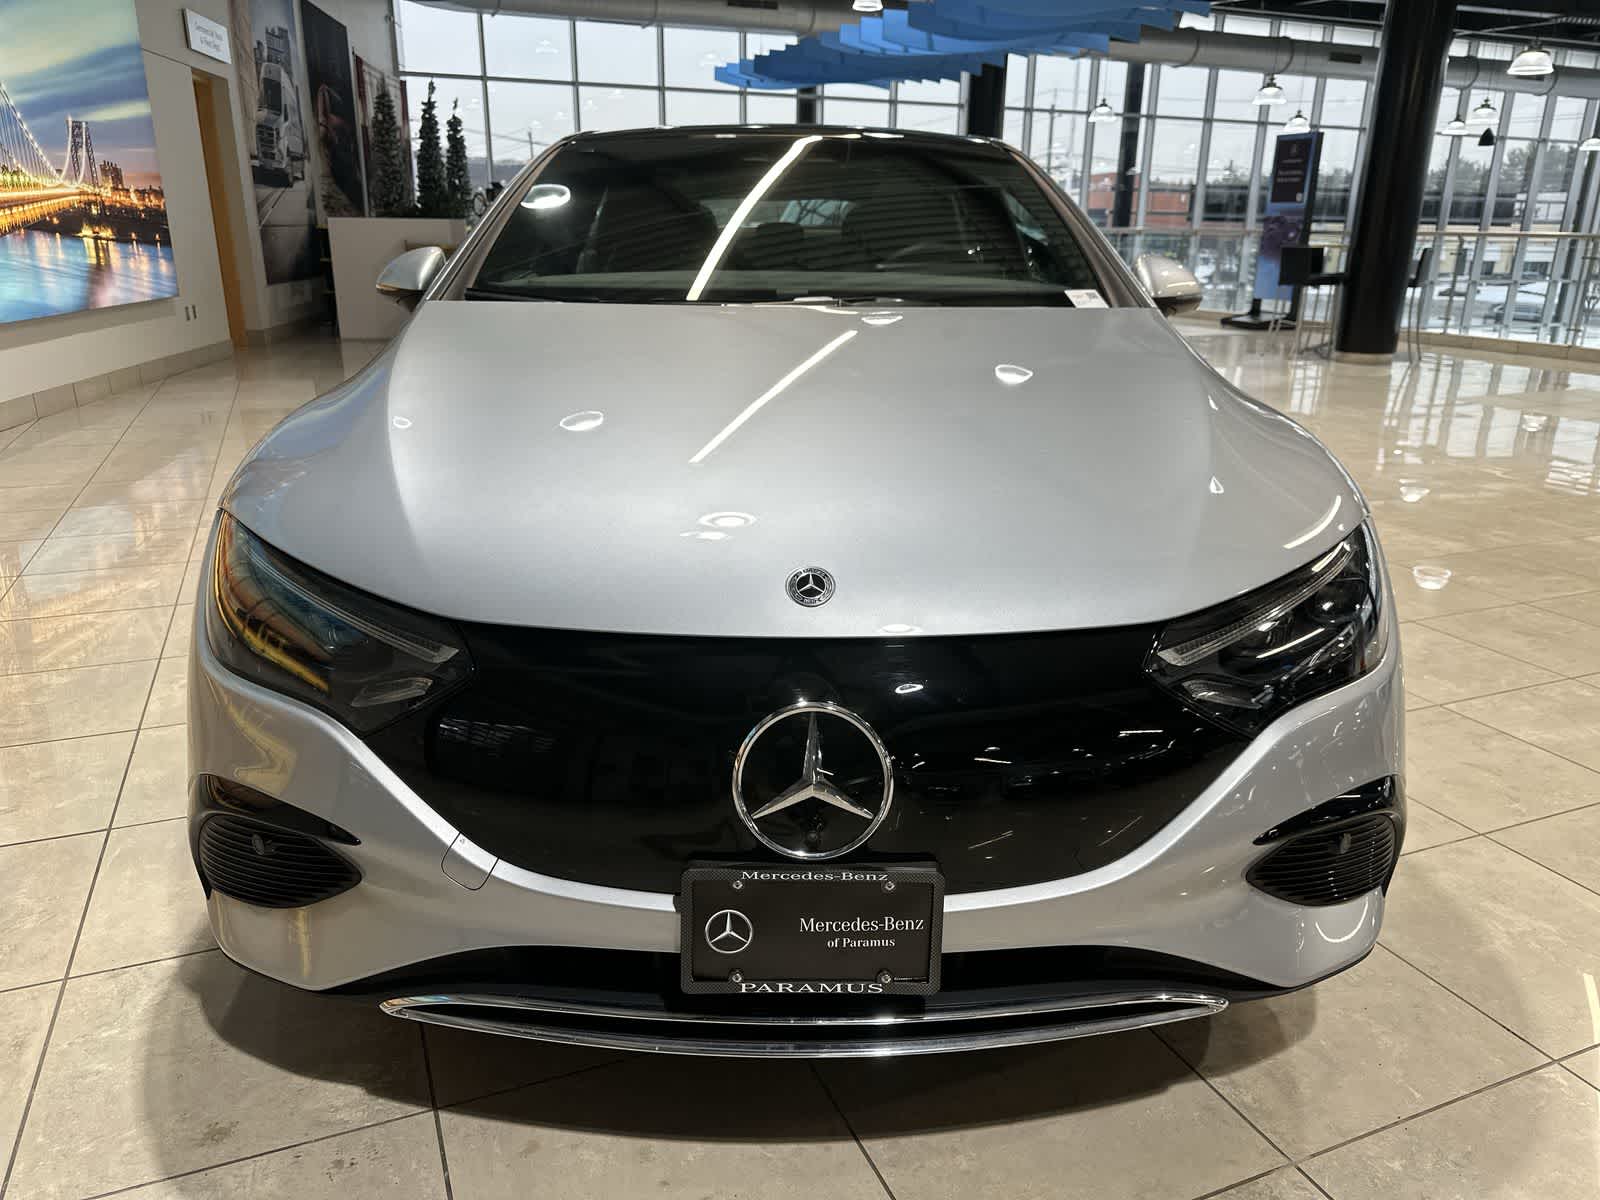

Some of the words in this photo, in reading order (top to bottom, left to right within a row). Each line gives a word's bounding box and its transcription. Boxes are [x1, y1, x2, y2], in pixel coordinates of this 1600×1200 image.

[741, 871, 889, 881] Mercedes-Benz
[799, 916, 924, 933] Mercedes-Benz
[827, 937, 841, 948] of
[842, 937, 896, 948] Paramus
[740, 983, 884, 993] PARAMUS
